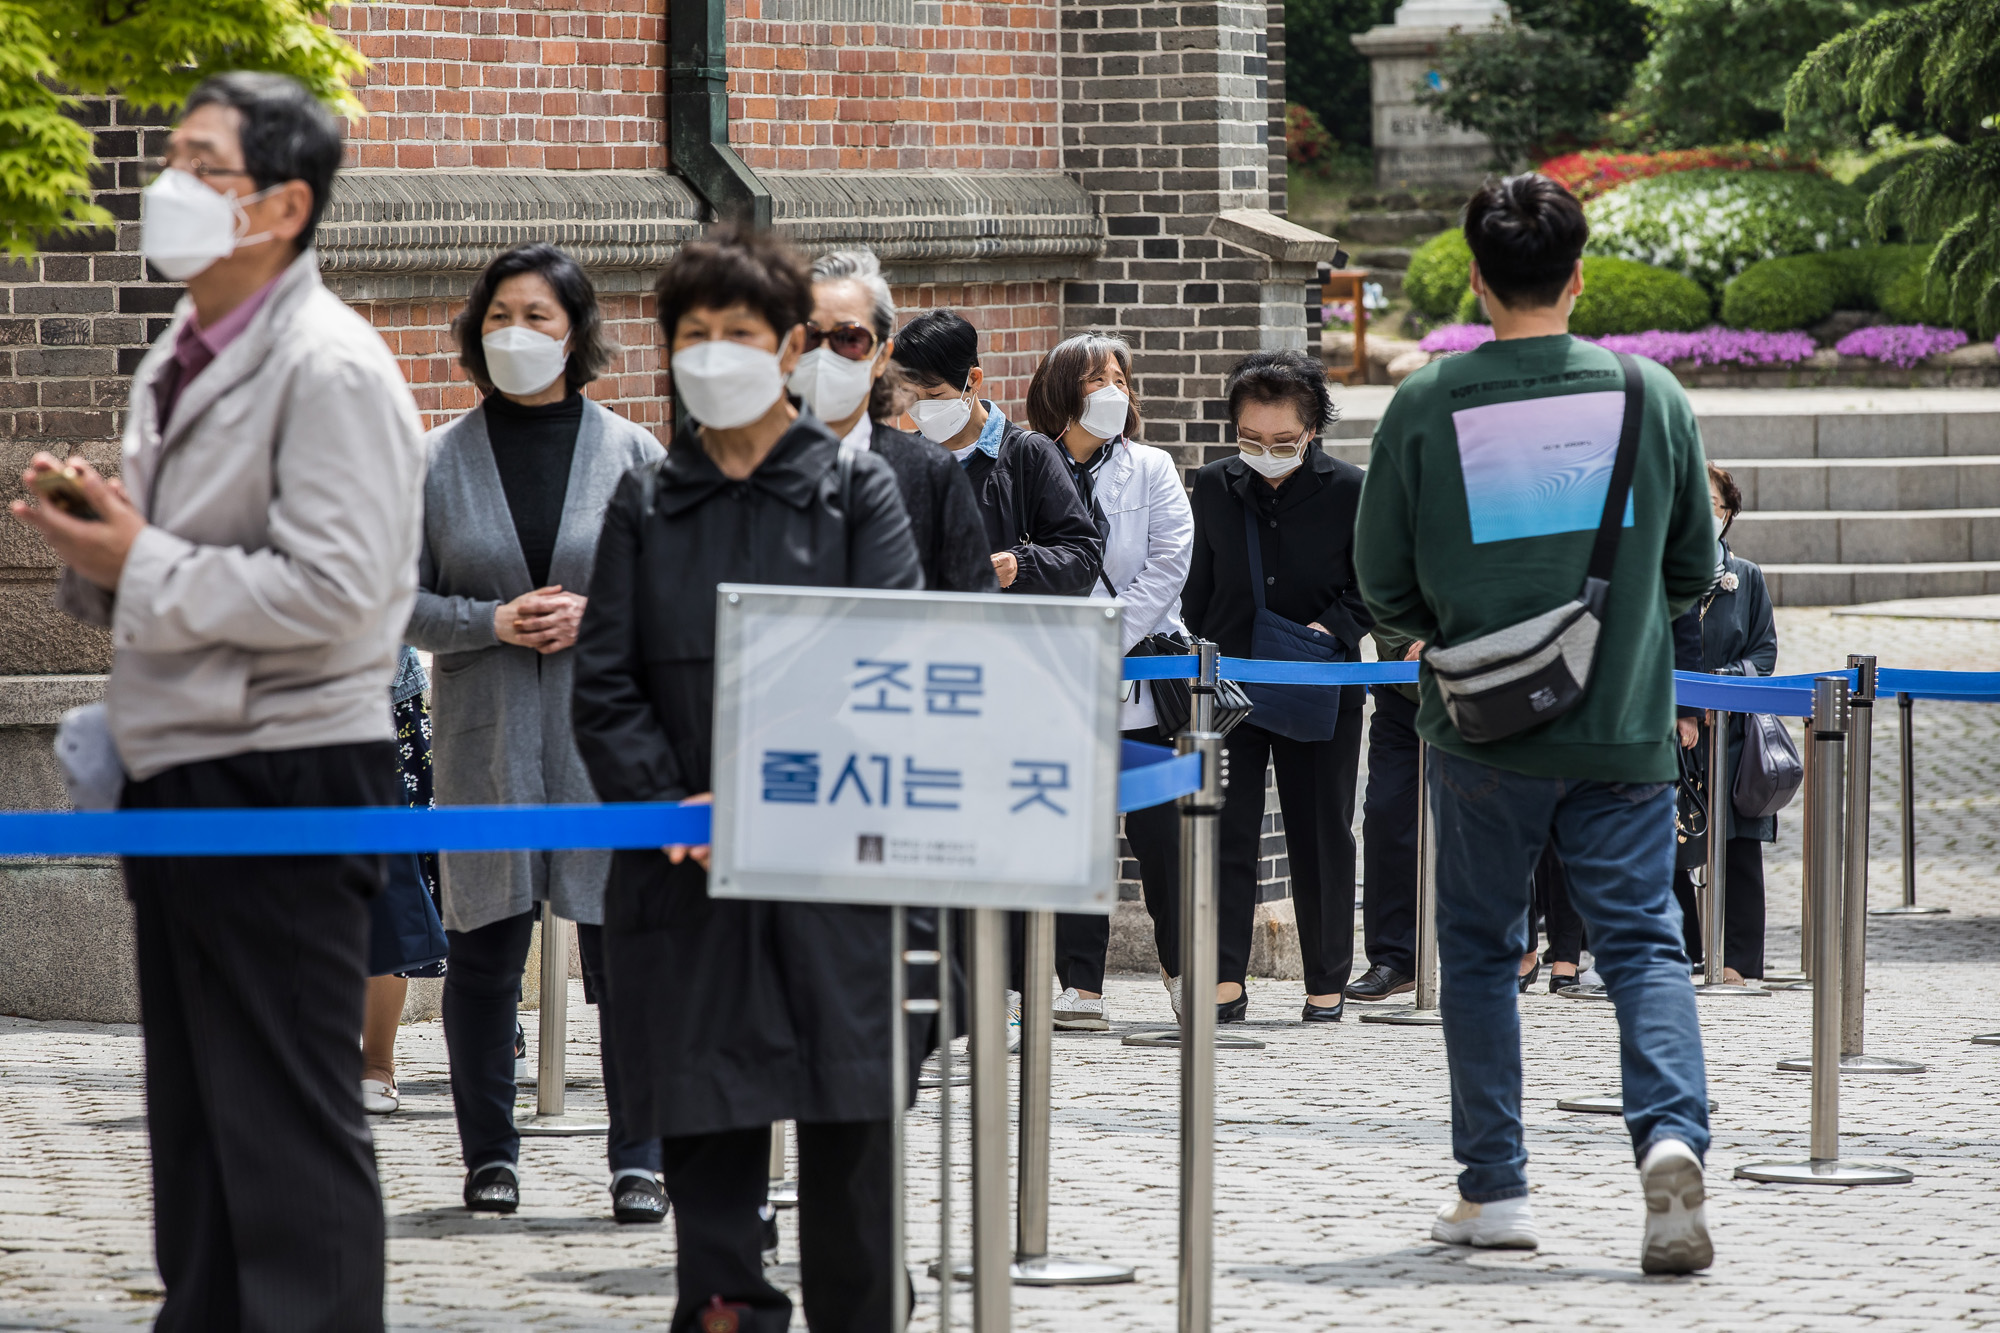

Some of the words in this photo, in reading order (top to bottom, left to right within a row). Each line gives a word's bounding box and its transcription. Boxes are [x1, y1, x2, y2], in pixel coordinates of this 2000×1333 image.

[1481, 379, 1519, 391] RITUAL
[1522, 378, 1538, 389] OF
[851, 658, 984, 716] 조문
[760, 750, 963, 811] 줄서는
[1009, 759, 1070, 817] 곳
